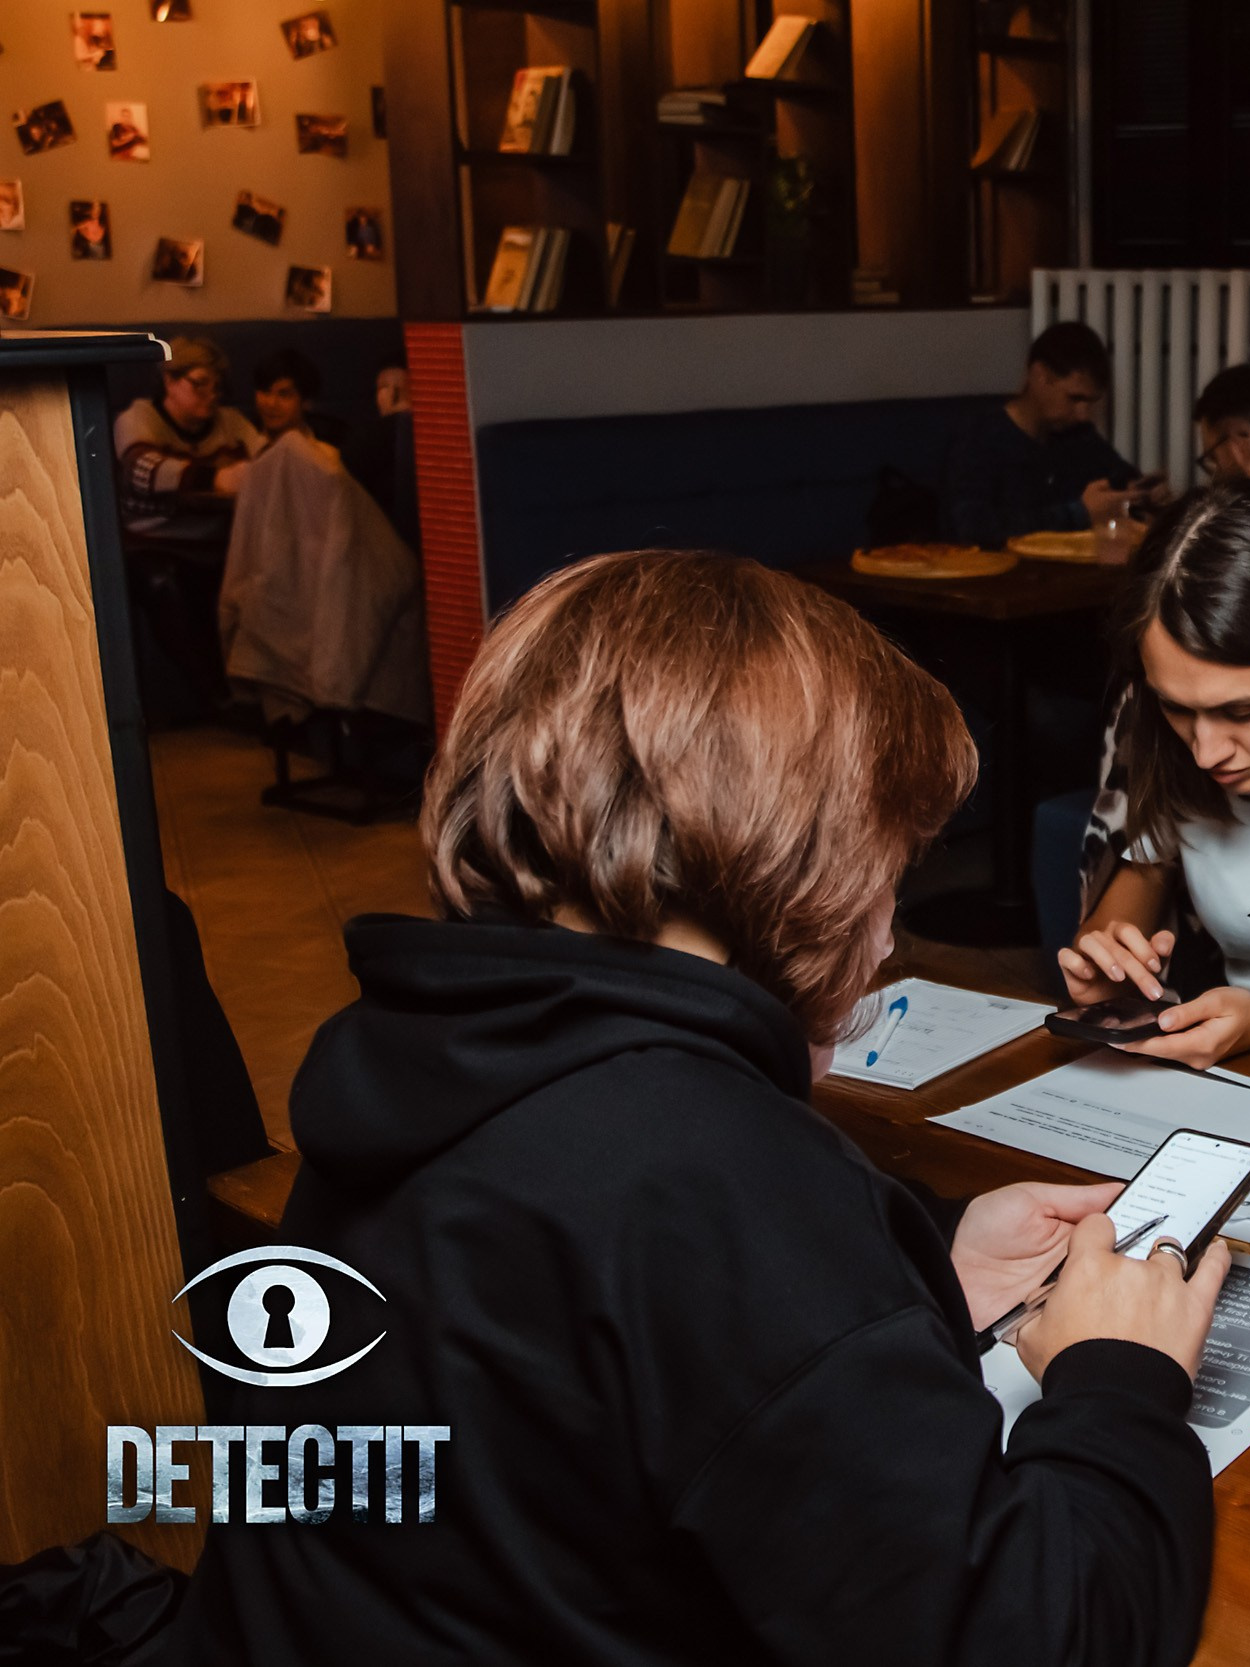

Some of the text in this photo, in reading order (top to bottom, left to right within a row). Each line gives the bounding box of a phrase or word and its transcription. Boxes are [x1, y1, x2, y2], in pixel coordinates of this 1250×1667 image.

[1225, 1307, 1248, 1319] first
[1205, 1339, 1232, 1348] ошо
[1203, 1347, 1234, 1357] речу
